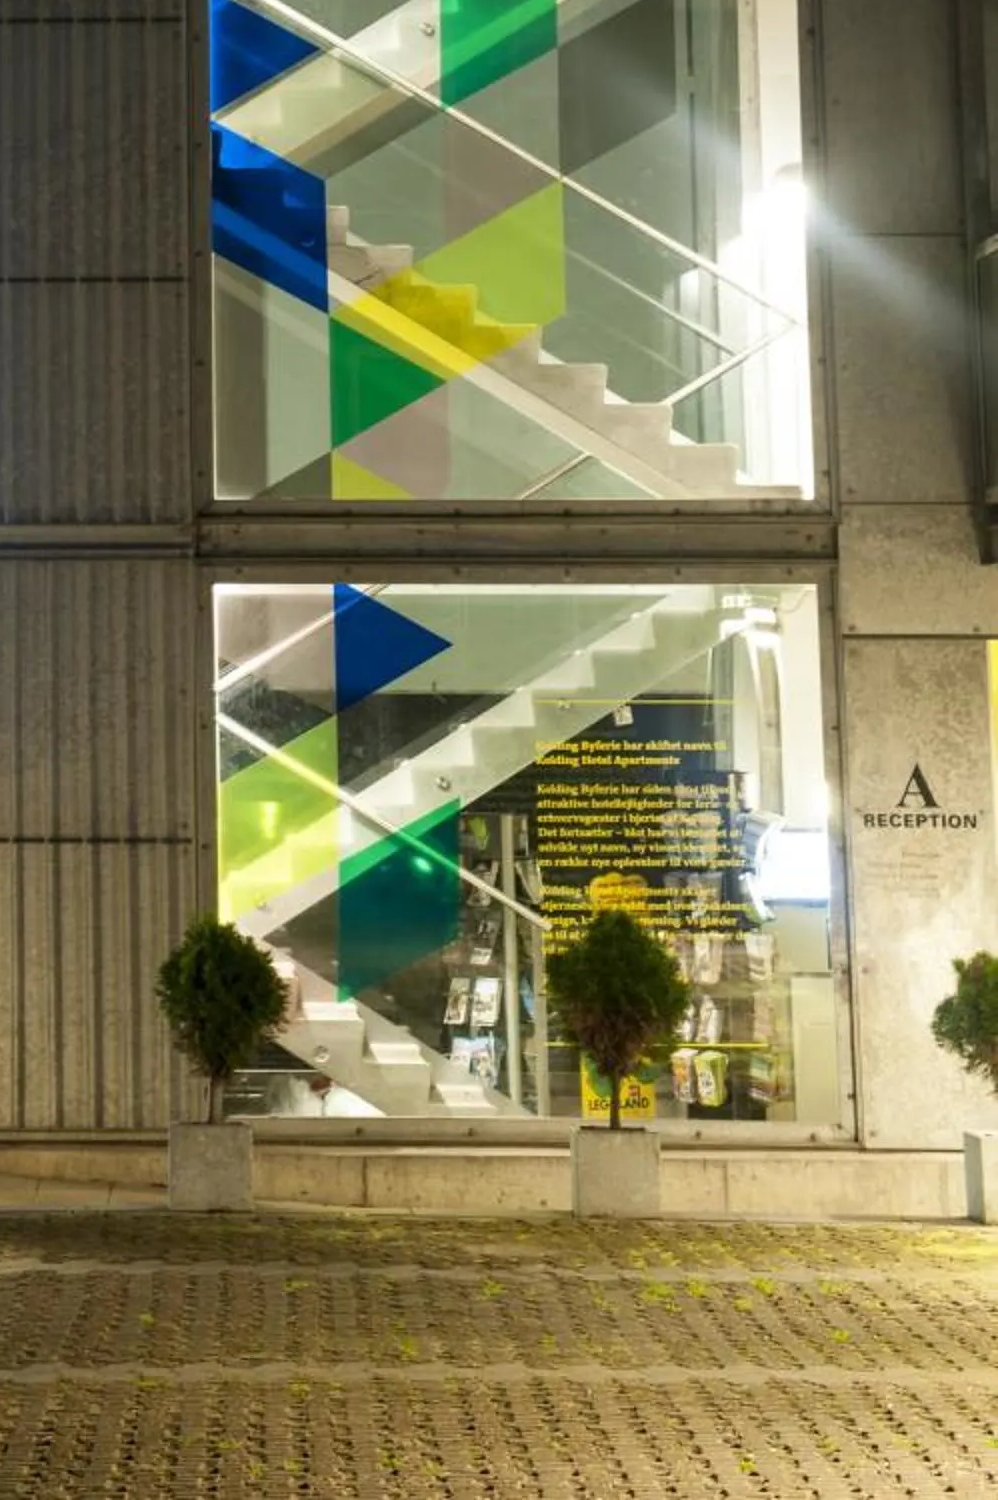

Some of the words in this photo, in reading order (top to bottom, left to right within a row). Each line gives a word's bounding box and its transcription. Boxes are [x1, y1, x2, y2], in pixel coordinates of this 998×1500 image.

[537, 755, 578, 767] Kolding
[582, 755, 611, 765] Hotel
[537, 784, 578, 796] Kolding
[895, 762, 941, 808] A
[863, 813, 977, 828] RECEPTION
[588, 1097, 650, 1110] LEGLAND
